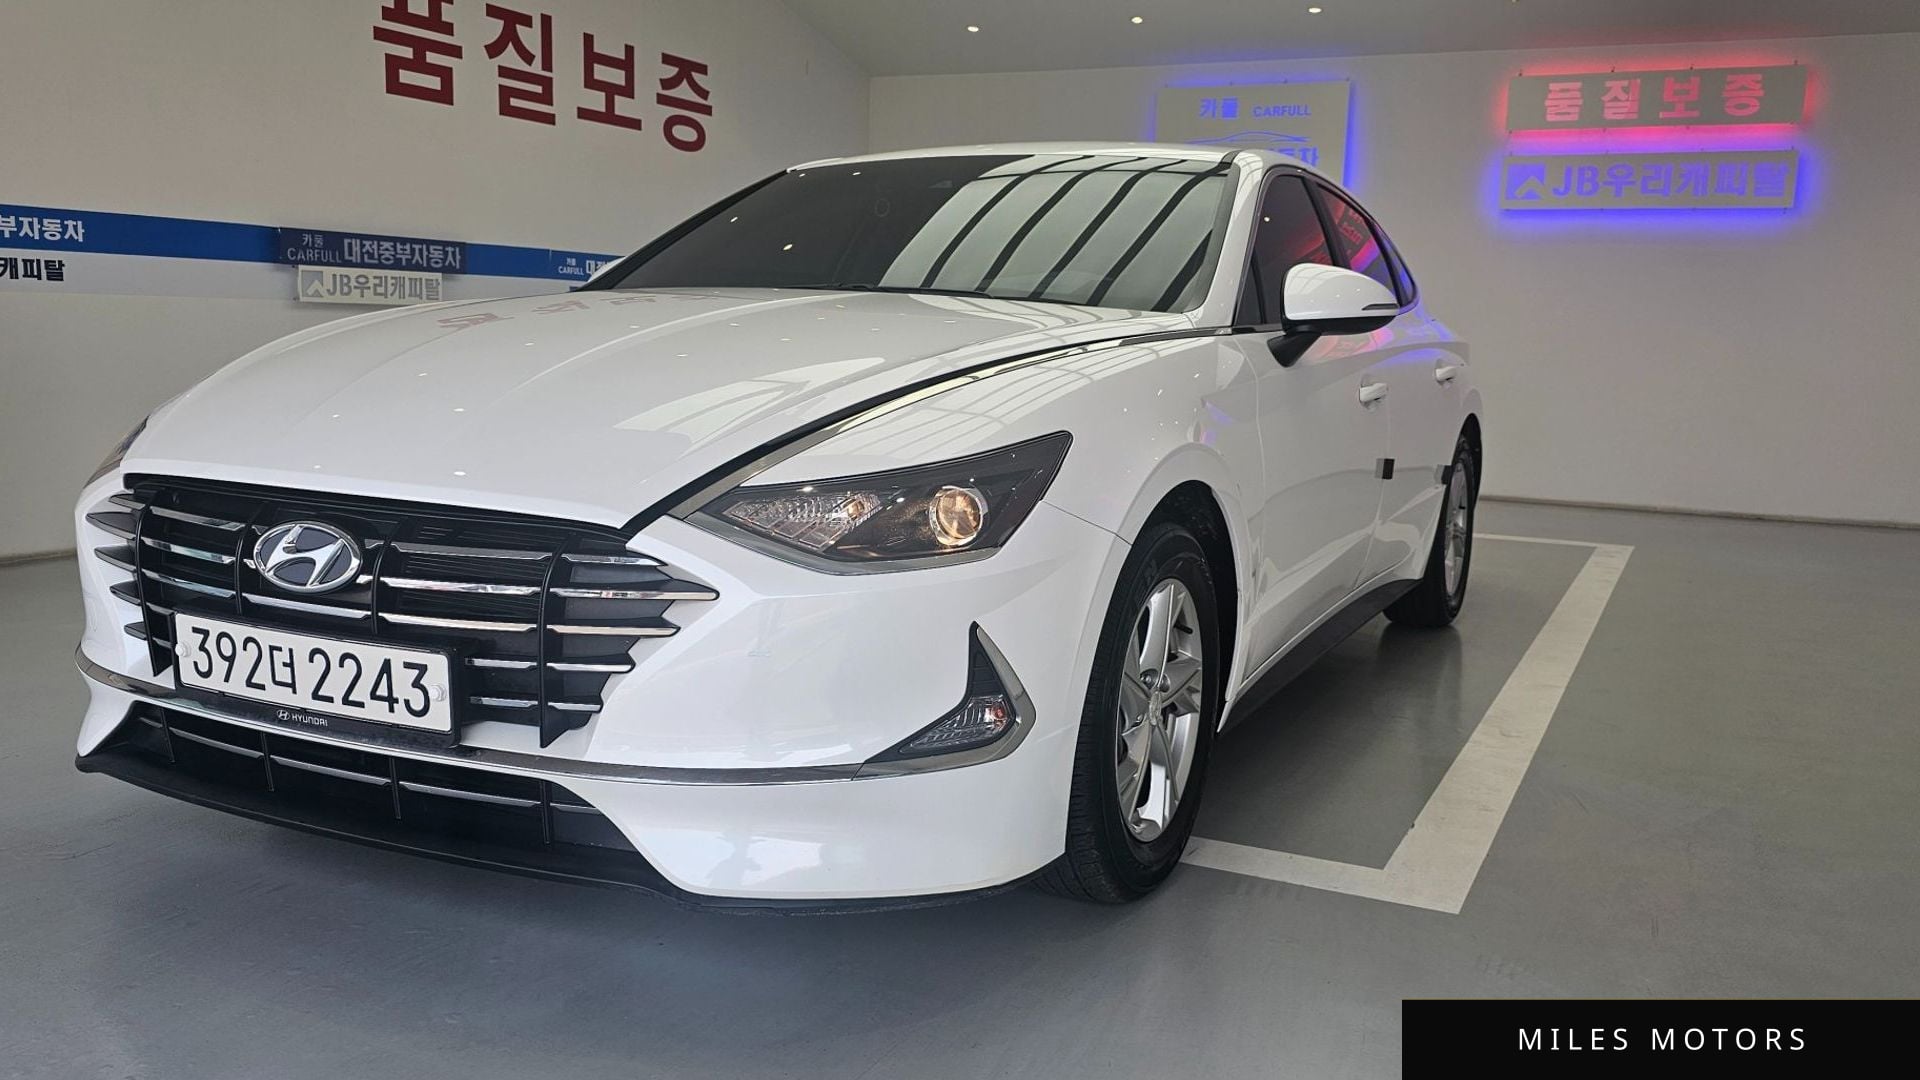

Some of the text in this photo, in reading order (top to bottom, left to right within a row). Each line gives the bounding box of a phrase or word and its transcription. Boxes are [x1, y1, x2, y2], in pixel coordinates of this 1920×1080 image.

[373, 0, 713, 152] 품질보증
[1253, 105, 1312, 118] CARFULL
[1544, 73, 1765, 122] 품질보증
[1552, 161, 1791, 198] JB우리캐피탈
[0, 215, 85, 242] 부자동차
[287, 247, 342, 264] CARFULL
[343, 238, 461, 269] 대전중부자동차
[326, 273, 440, 300] JB우리캐피탈
[191, 626, 431, 718] 392더 2243
[291, 713, 328, 727] HYUNDAI
